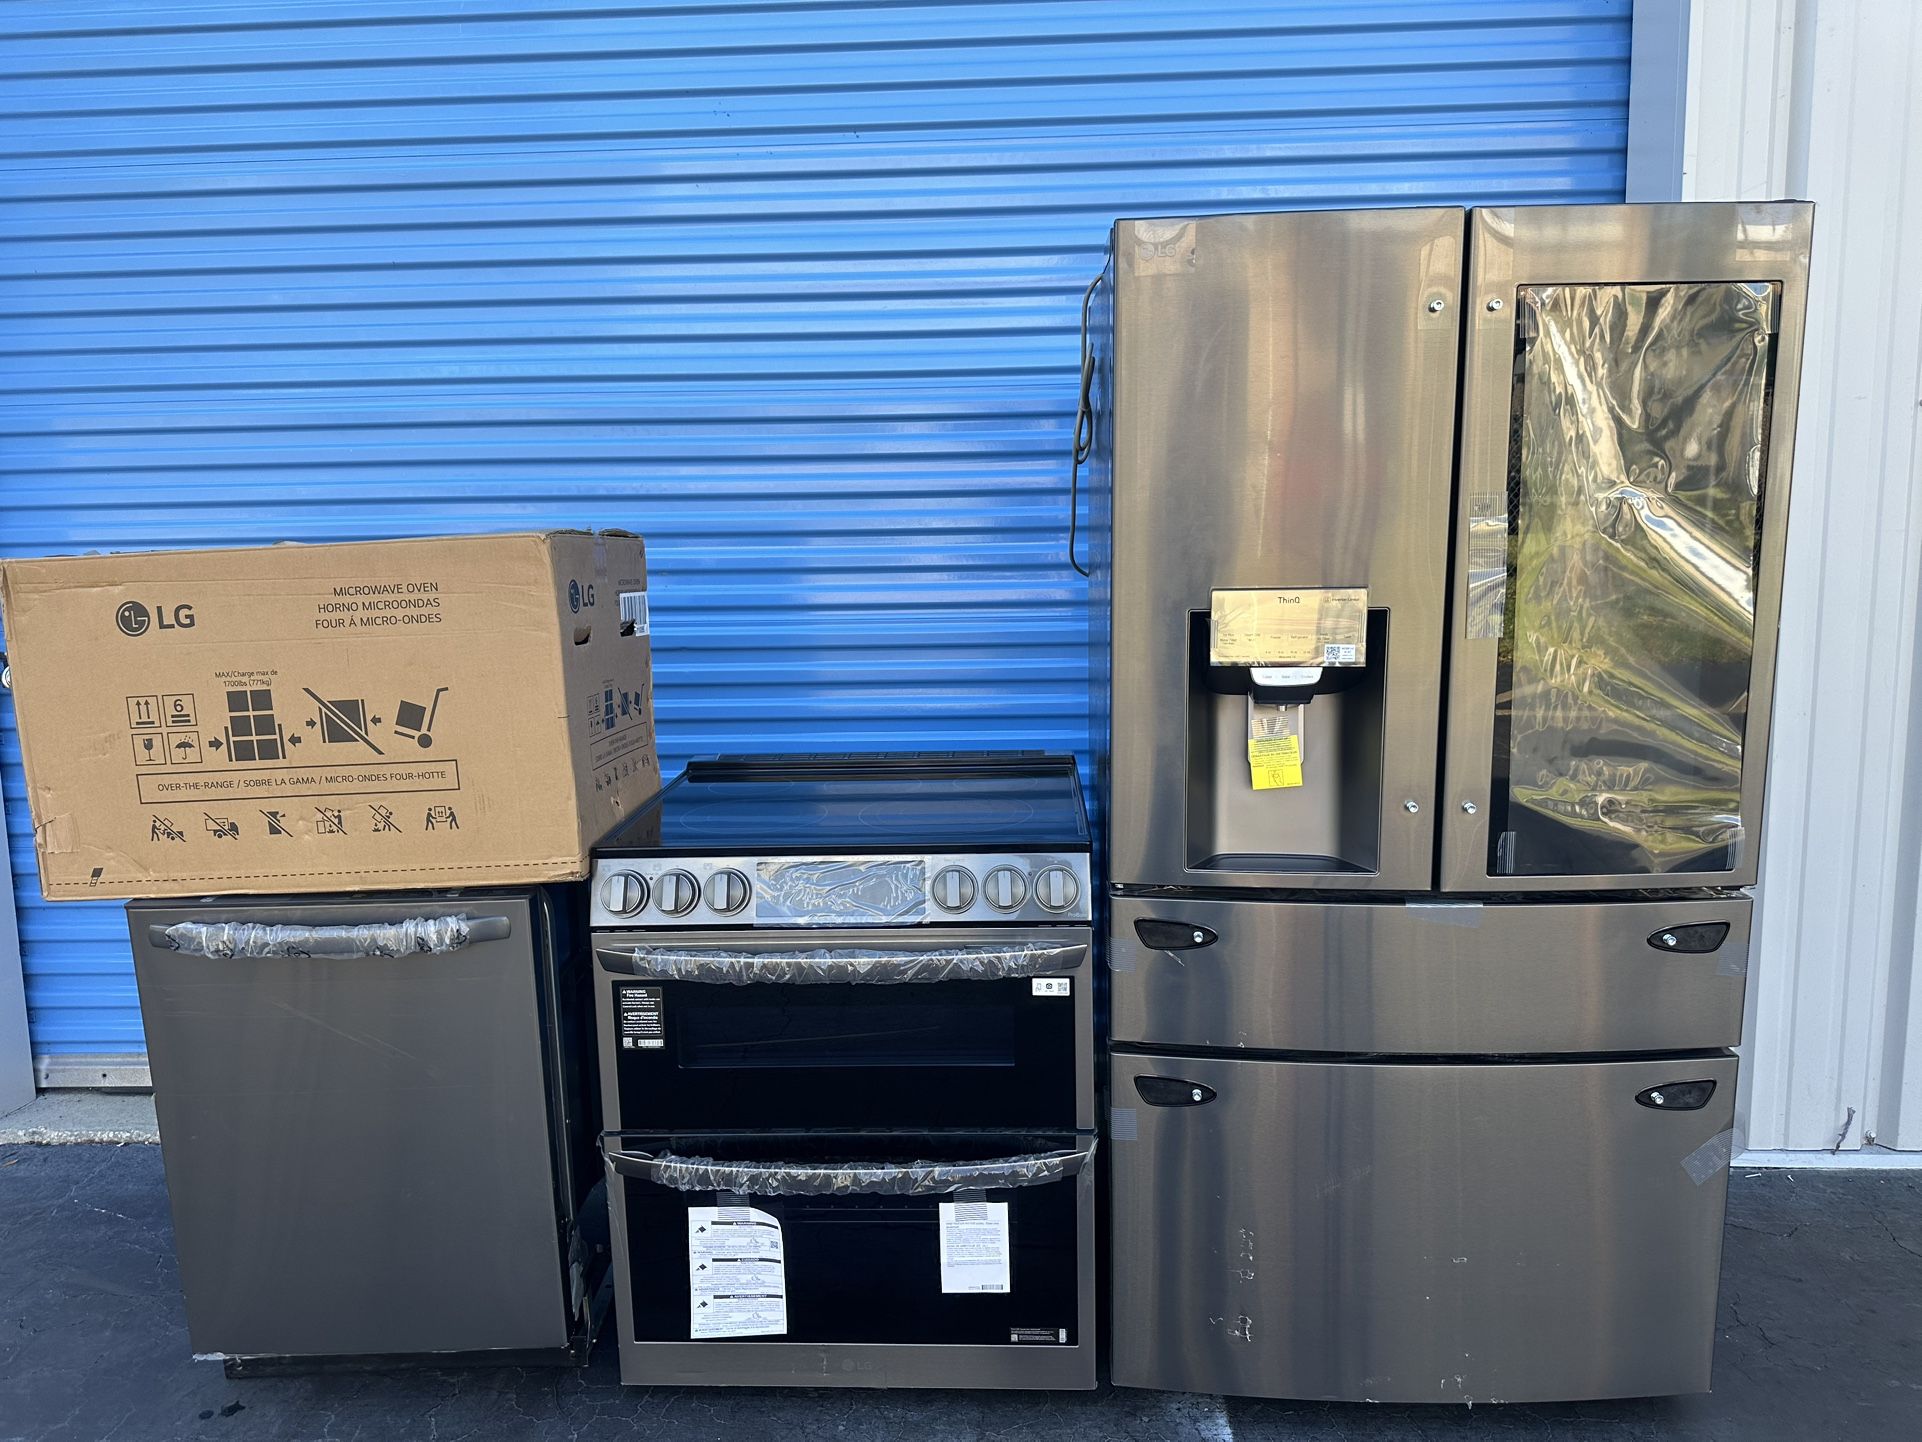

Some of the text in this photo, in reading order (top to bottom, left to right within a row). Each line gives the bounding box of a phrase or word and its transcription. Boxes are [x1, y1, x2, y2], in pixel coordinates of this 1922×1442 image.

[333, 582, 439, 597] MICROWAVE OVEN
[581, 584, 595, 607] LG
[318, 597, 441, 613] HORNO MICROONDAS
[1278, 596, 1300, 604] ThinQ
[156, 604, 196, 630] LG
[315, 618, 346, 629] FOUR
[360, 613, 442, 627] MICRO-ONDES
[215, 670, 255, 678] MAX/Charge
[223, 678, 272, 688] 1700lbs (771kg)
[173, 699, 184, 713] 6
[157, 780, 235, 791] OVER-THE-RANGE
[243, 778, 272, 787] SOBRE
[275, 777, 287, 786] LA
[288, 776, 317, 785] GAMA
[325, 773, 388, 784] MICRO-ONDES
[390, 770, 446, 781] FOUR-HOTTE
